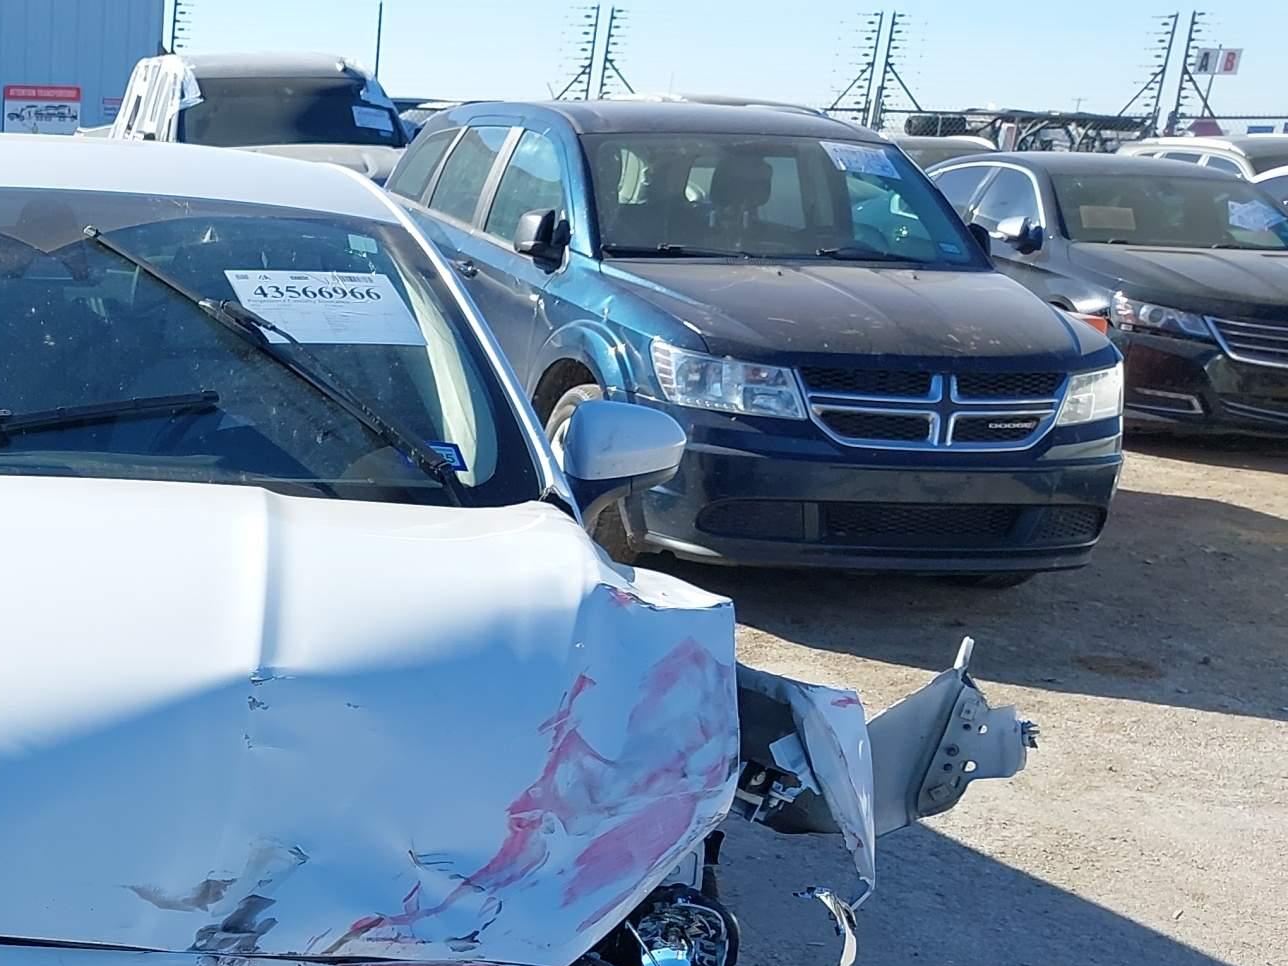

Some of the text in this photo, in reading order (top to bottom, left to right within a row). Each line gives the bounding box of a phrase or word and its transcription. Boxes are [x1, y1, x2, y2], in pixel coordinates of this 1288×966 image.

[1198, 52, 1237, 72] A B
[253, 285, 382, 301] 43566966
